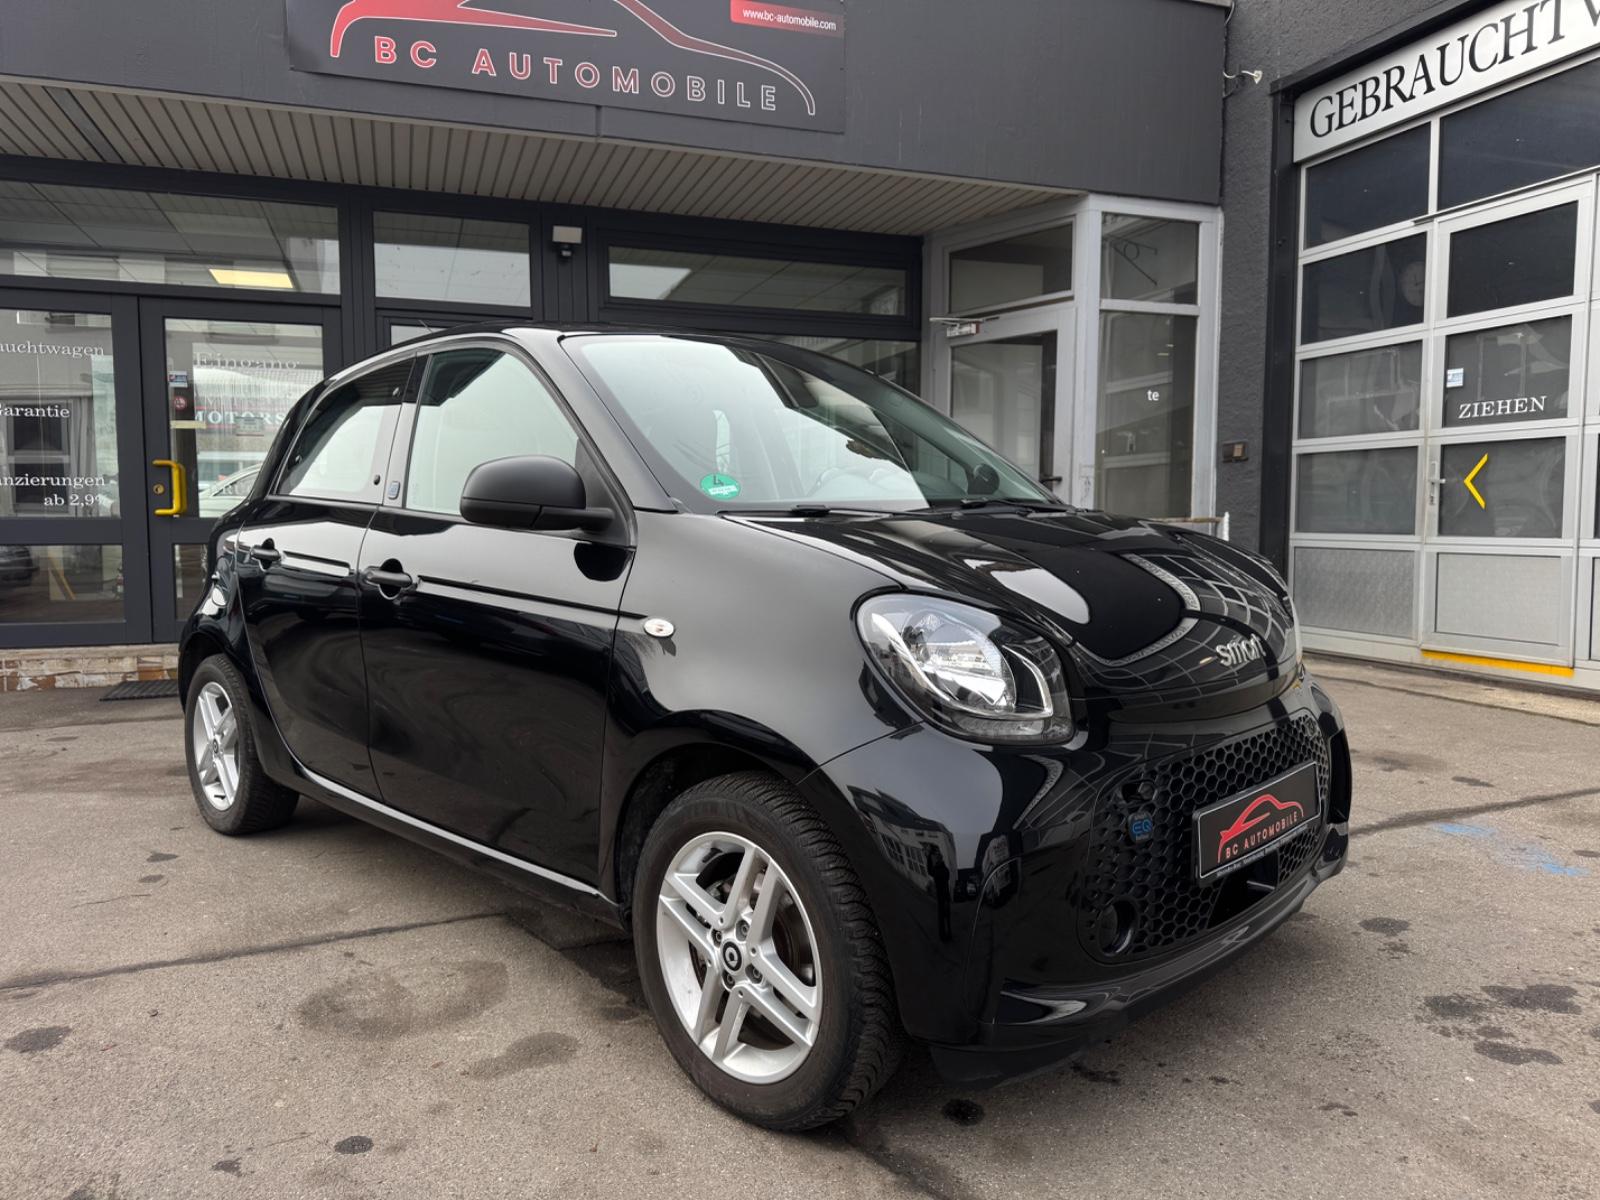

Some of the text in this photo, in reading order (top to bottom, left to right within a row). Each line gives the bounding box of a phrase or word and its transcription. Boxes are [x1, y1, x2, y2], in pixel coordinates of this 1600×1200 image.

[742, 8, 837, 31] www.bc-automobile.com
[373, 36, 777, 111] BC AUTOMOBILE
[1309, 0, 1600, 138] GEBRAUCHT
[1146, 389, 1160, 401] te
[1458, 395, 1547, 419] ZIEHEN
[44, 493, 65, 506] ab
[1215, 633, 1267, 667] smart
[1225, 843, 1239, 859] BC
[1243, 811, 1298, 849] AUTOMOBILE
